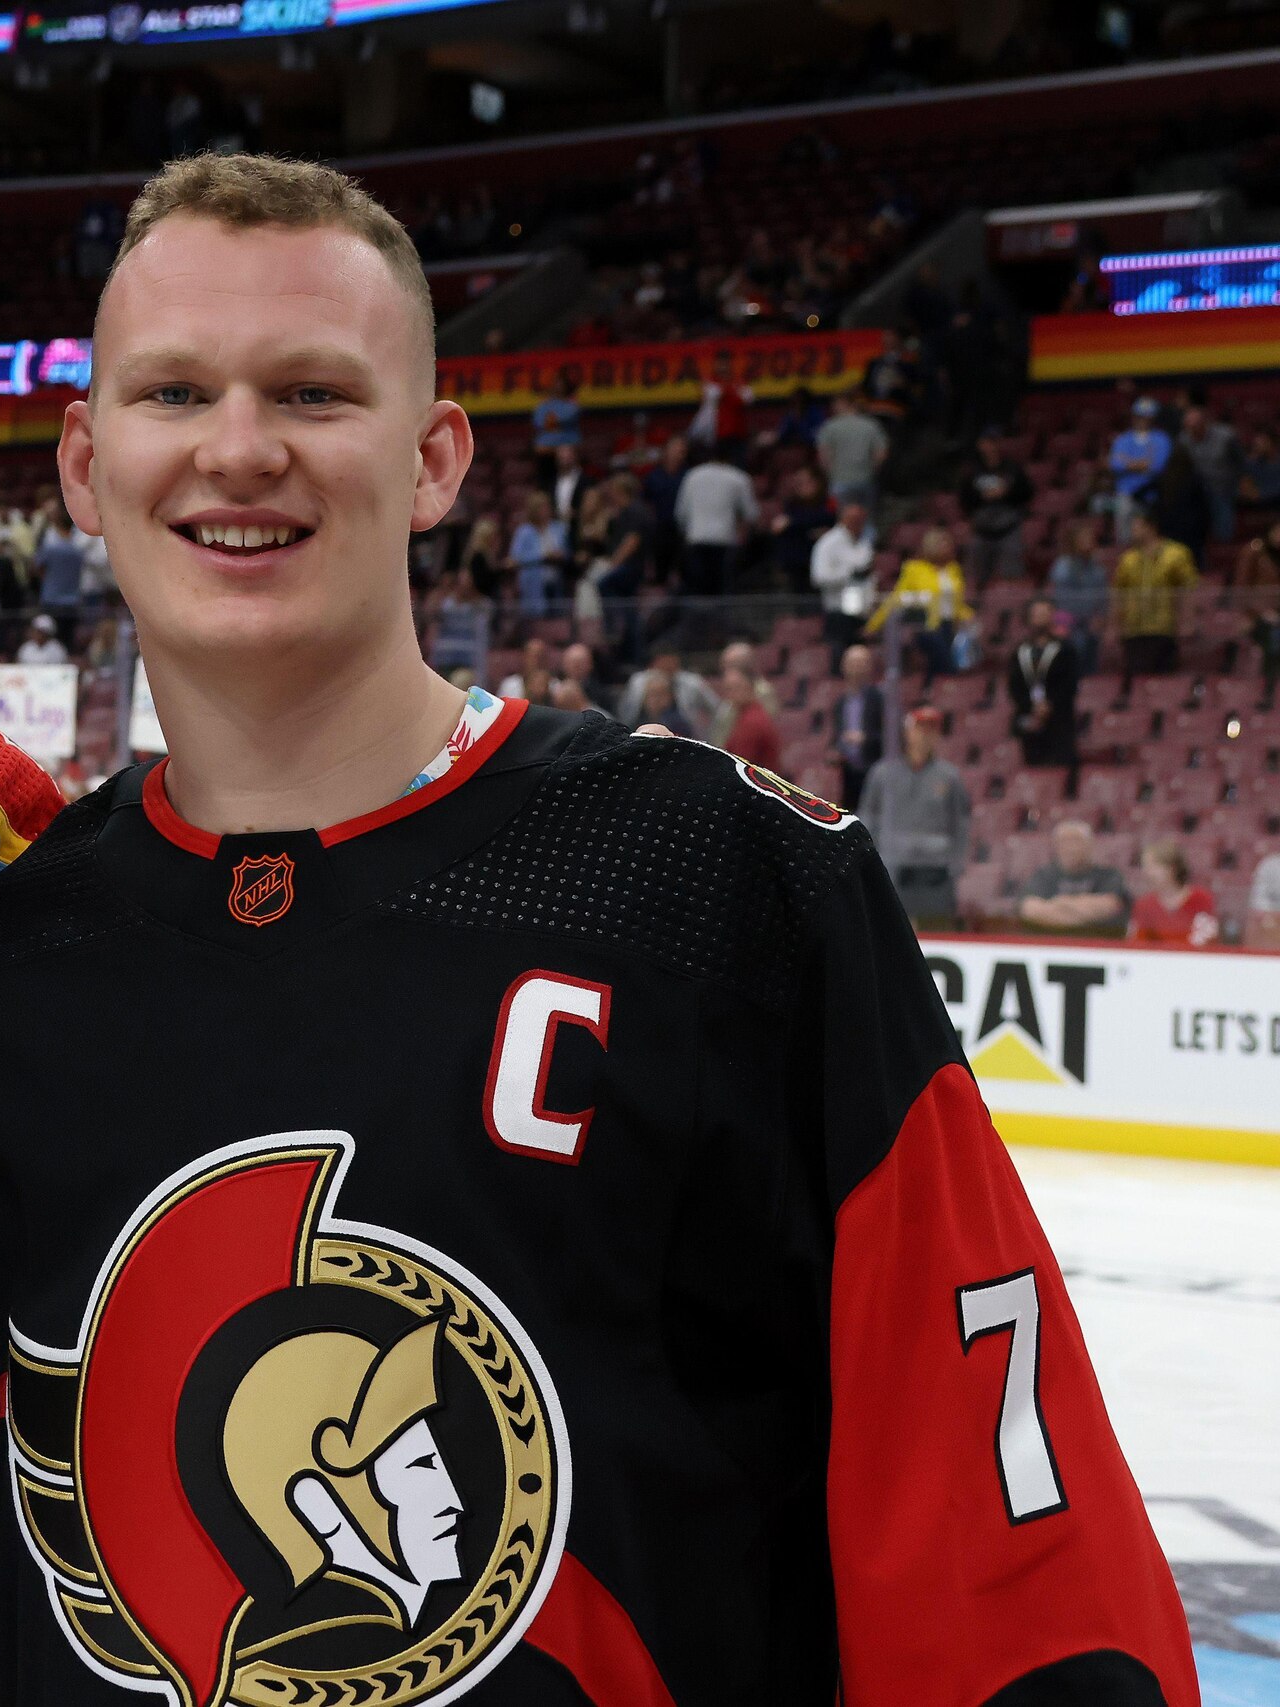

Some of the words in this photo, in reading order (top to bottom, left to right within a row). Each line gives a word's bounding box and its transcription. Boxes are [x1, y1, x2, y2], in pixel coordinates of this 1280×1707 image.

[244, 873, 282, 910] NHL
[482, 968, 613, 1167] C
[1172, 1008, 1260, 1054] LET'S
[954, 1265, 1070, 1528] 7
